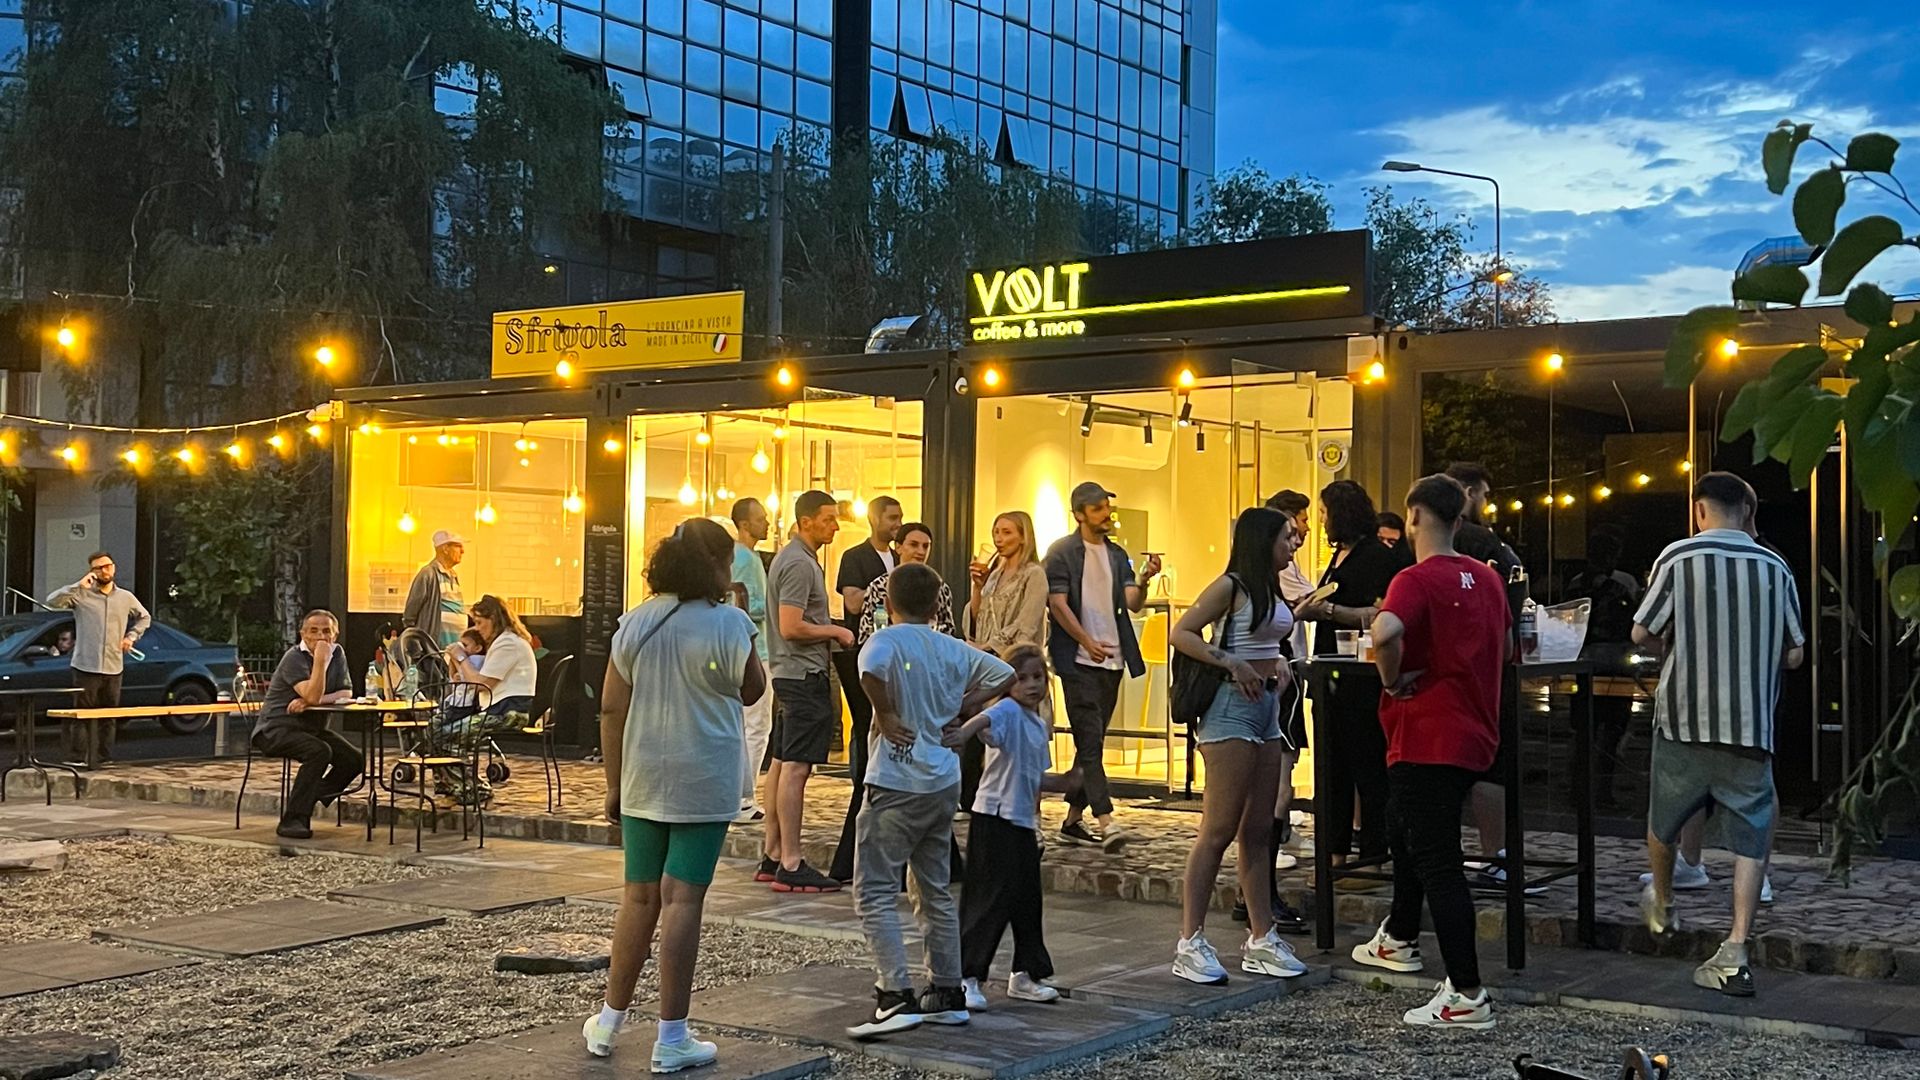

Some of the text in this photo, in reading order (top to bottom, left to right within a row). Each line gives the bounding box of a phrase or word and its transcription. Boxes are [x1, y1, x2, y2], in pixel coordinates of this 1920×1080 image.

[973, 263, 1089, 316] VOLT
[707, 316, 732, 328] VISTA
[973, 319, 1086, 340] coffee & more
[505, 310, 627, 361] Sfrigola
[646, 333, 708, 347] MADE IN SICILY
